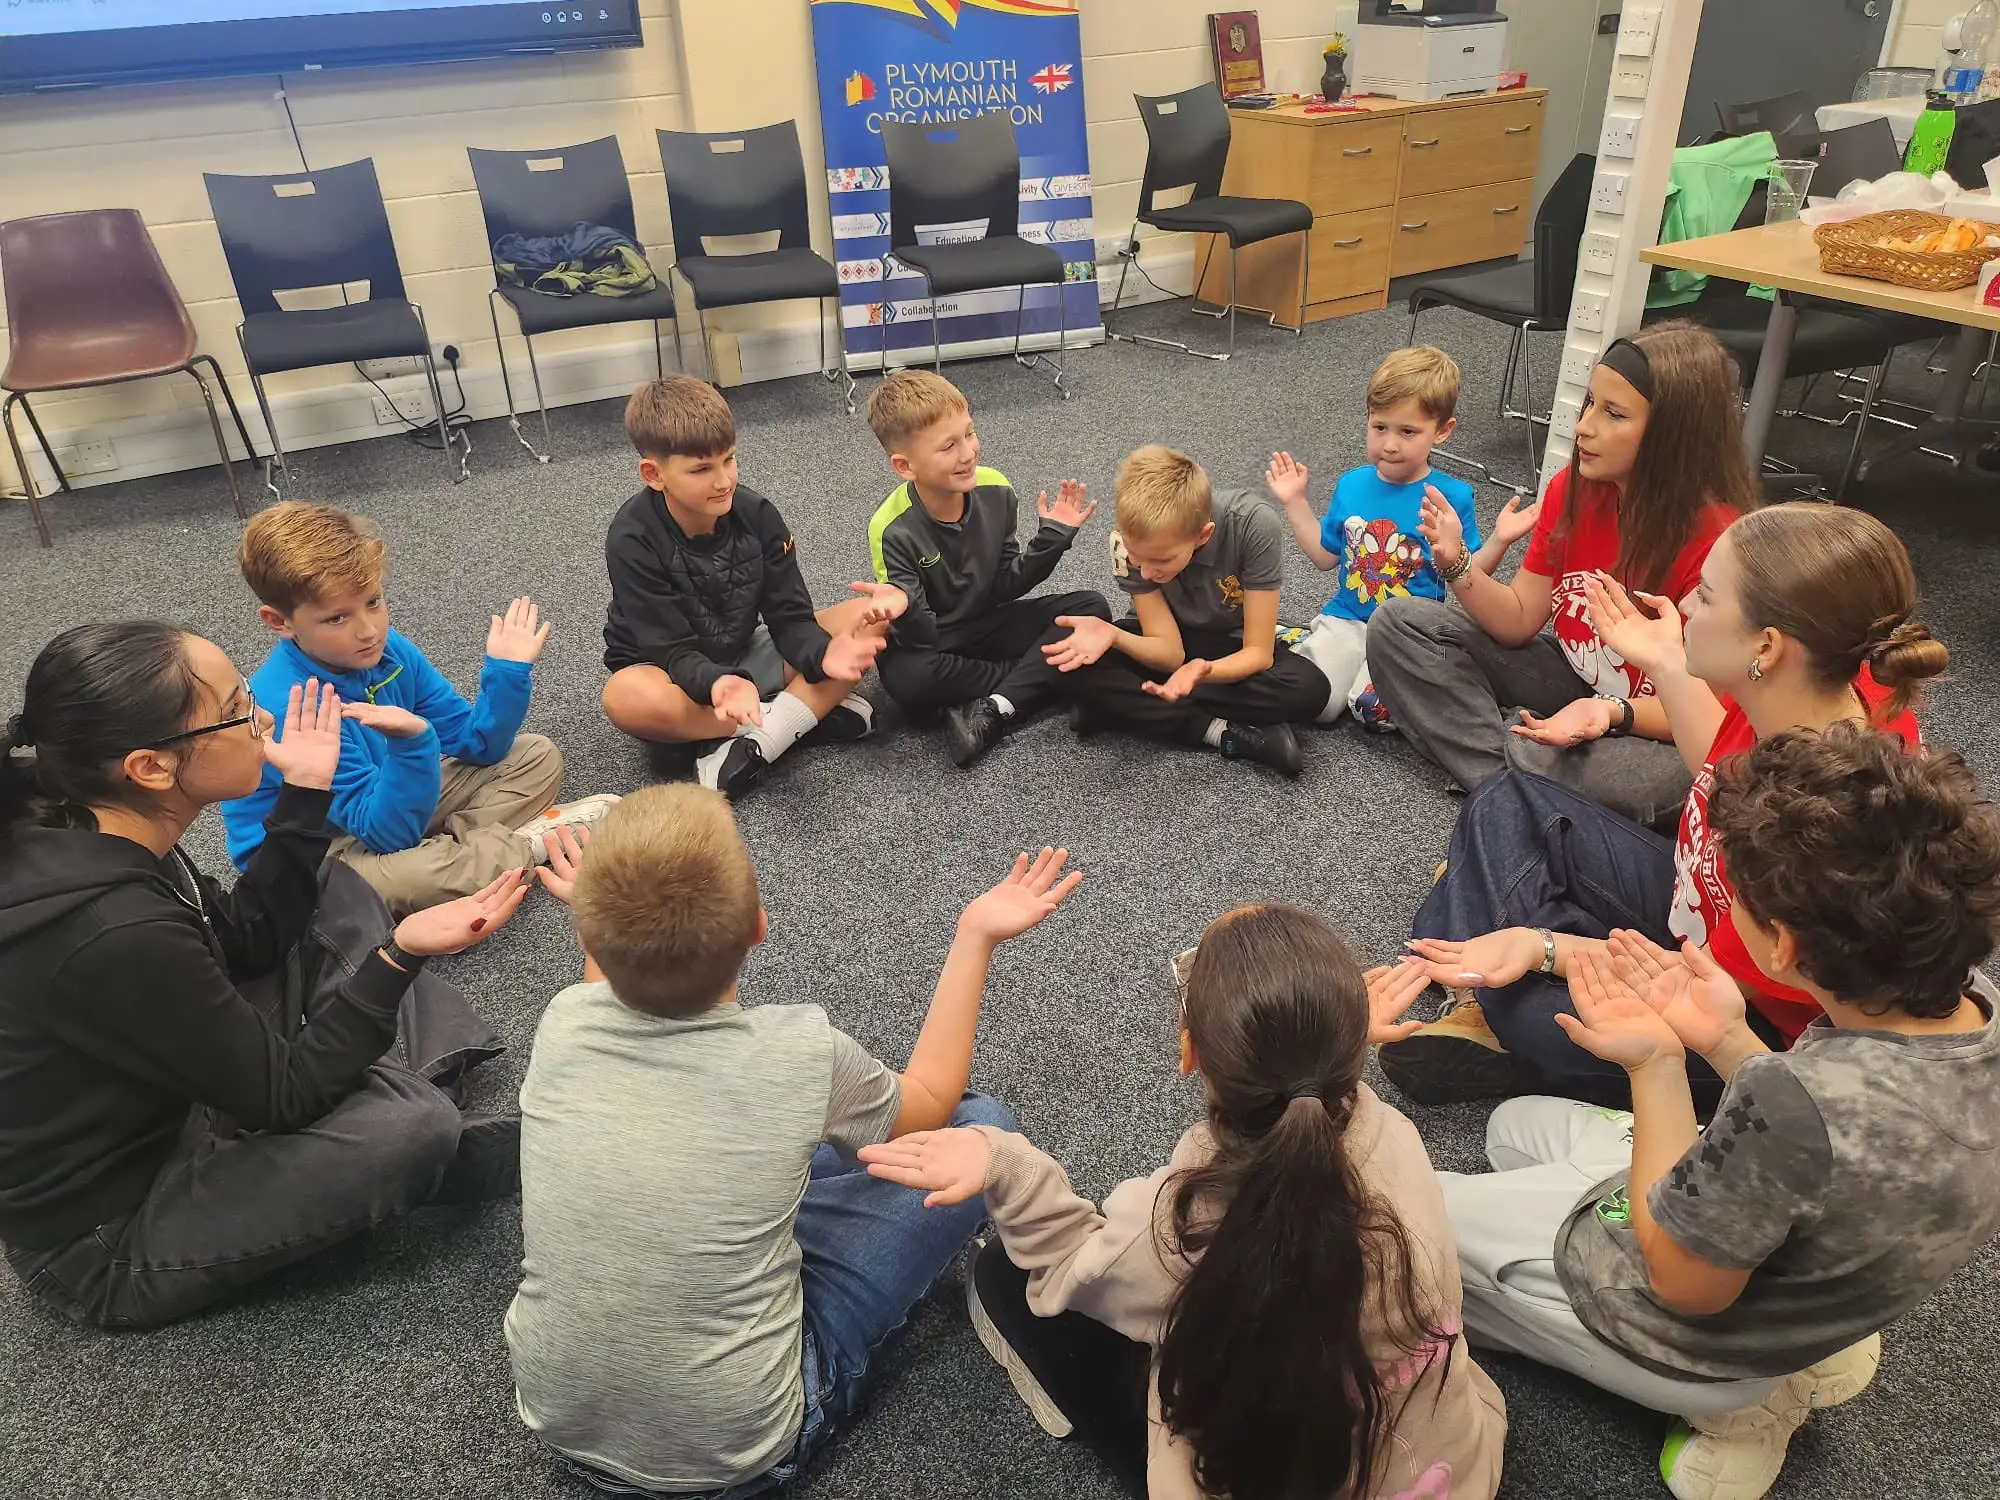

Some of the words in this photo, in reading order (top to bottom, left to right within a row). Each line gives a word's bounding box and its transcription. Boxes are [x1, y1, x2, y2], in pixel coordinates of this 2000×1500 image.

[885, 60, 1017, 86] PLYMOUTH
[890, 83, 1017, 109] ROMANIAN
[901, 303, 959, 316] Collaboation
[1702, 844, 1729, 914] CHIEV
